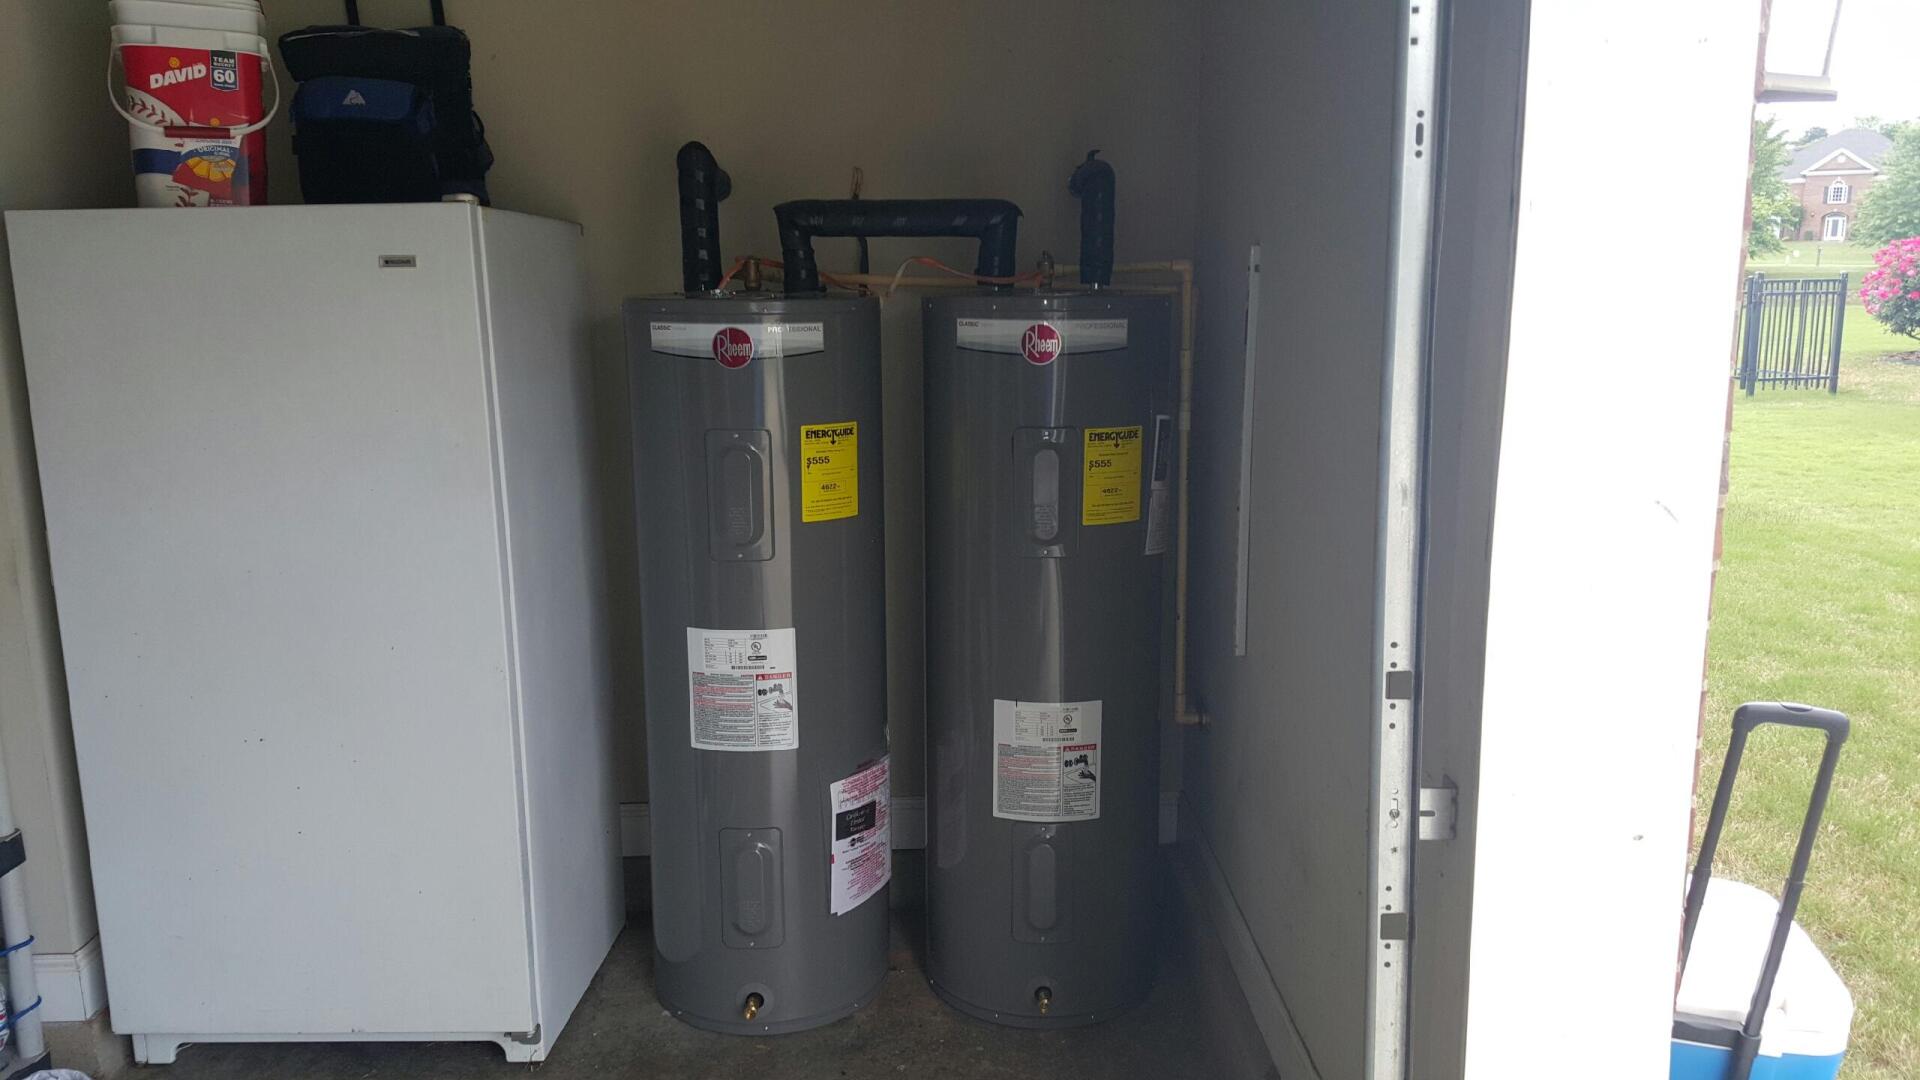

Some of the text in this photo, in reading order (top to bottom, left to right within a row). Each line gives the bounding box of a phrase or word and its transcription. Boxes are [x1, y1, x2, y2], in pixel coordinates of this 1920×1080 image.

[213, 56, 235, 64] TEAM
[149, 62, 207, 89] DAVID
[213, 69, 235, 83] 60
[716, 328, 751, 361] Rheem
[1025, 324, 1058, 358] Rheem
[806, 456, 830, 465] $555
[1088, 460, 1112, 468] $555
